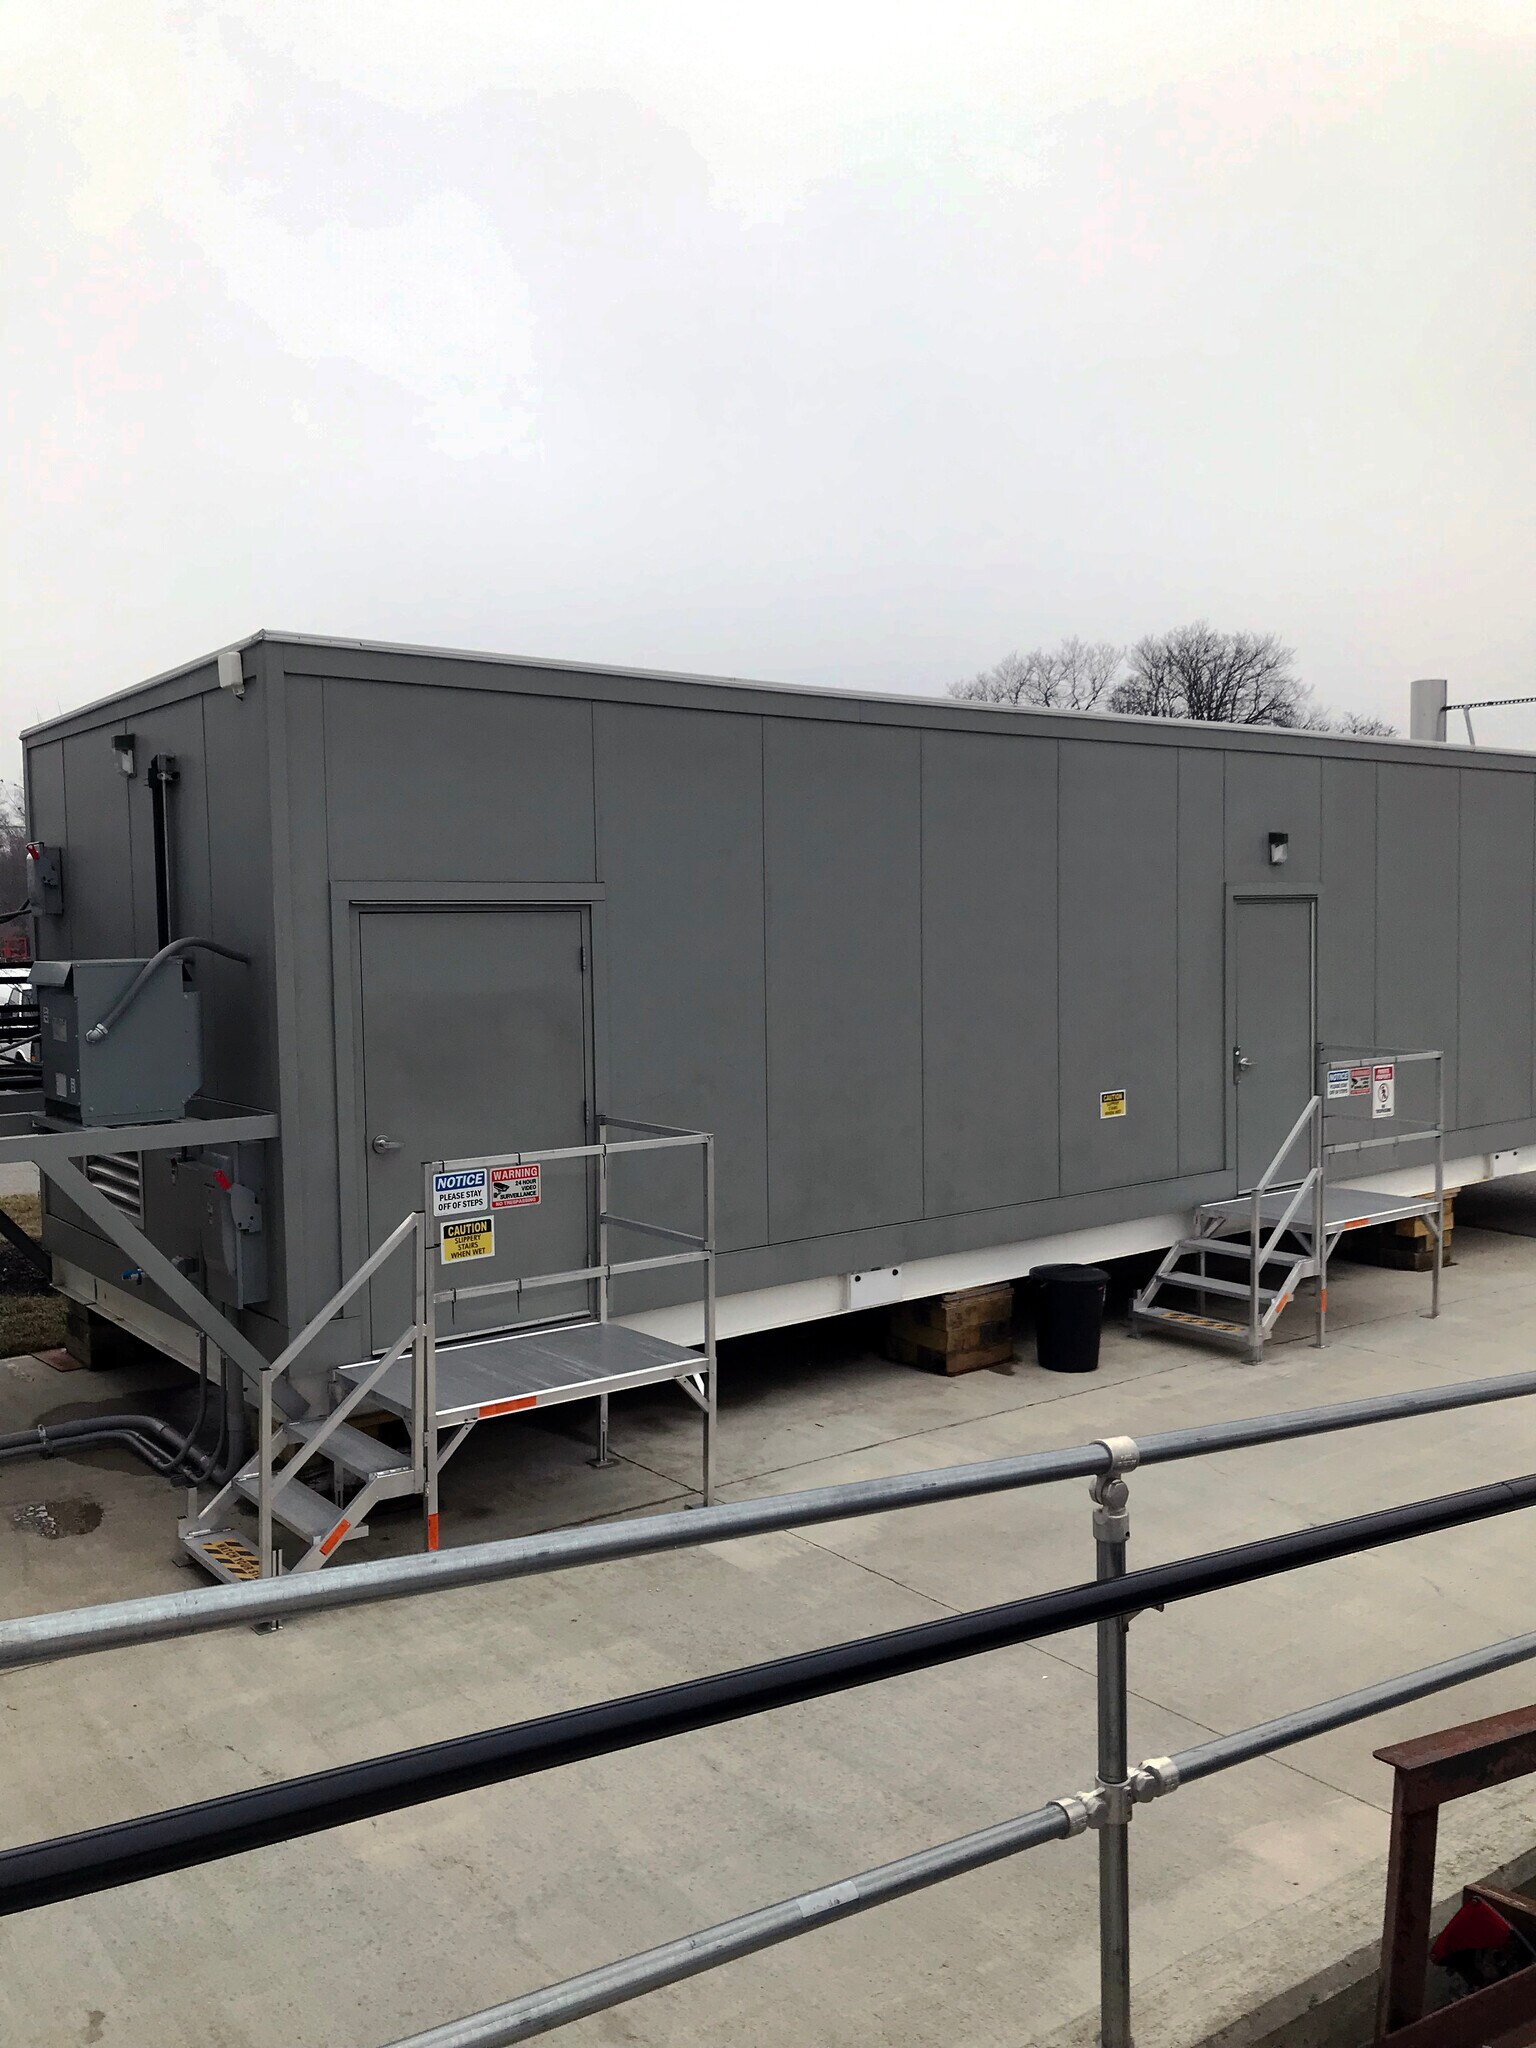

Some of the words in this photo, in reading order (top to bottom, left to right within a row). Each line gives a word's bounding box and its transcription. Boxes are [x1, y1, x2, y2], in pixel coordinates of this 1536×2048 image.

[1329, 1073, 1348, 1081] NOTICE
[1103, 1094, 1122, 1102] CAUTION
[494, 1167, 537, 1180] WARNING
[437, 1173, 484, 1190] NOTICE
[439, 1191, 464, 1201] PLEASE
[465, 1190, 482, 1198] STAY
[500, 1191, 536, 1200] SURVEILLANCE
[438, 1203, 451, 1211] OFF
[452, 1201, 461, 1209] OF
[462, 1199, 483, 1208] STEPS
[448, 1221, 487, 1237] CAUTION
[454, 1234, 481, 1244] SLIPPERY
[457, 1242, 479, 1250] STAIRS
[450, 1250, 471, 1259] WHEN
[472, 1247, 486, 1255] WET
[216, 1543, 240, 1559] WATCH
[235, 1557, 254, 1571] YOUR
